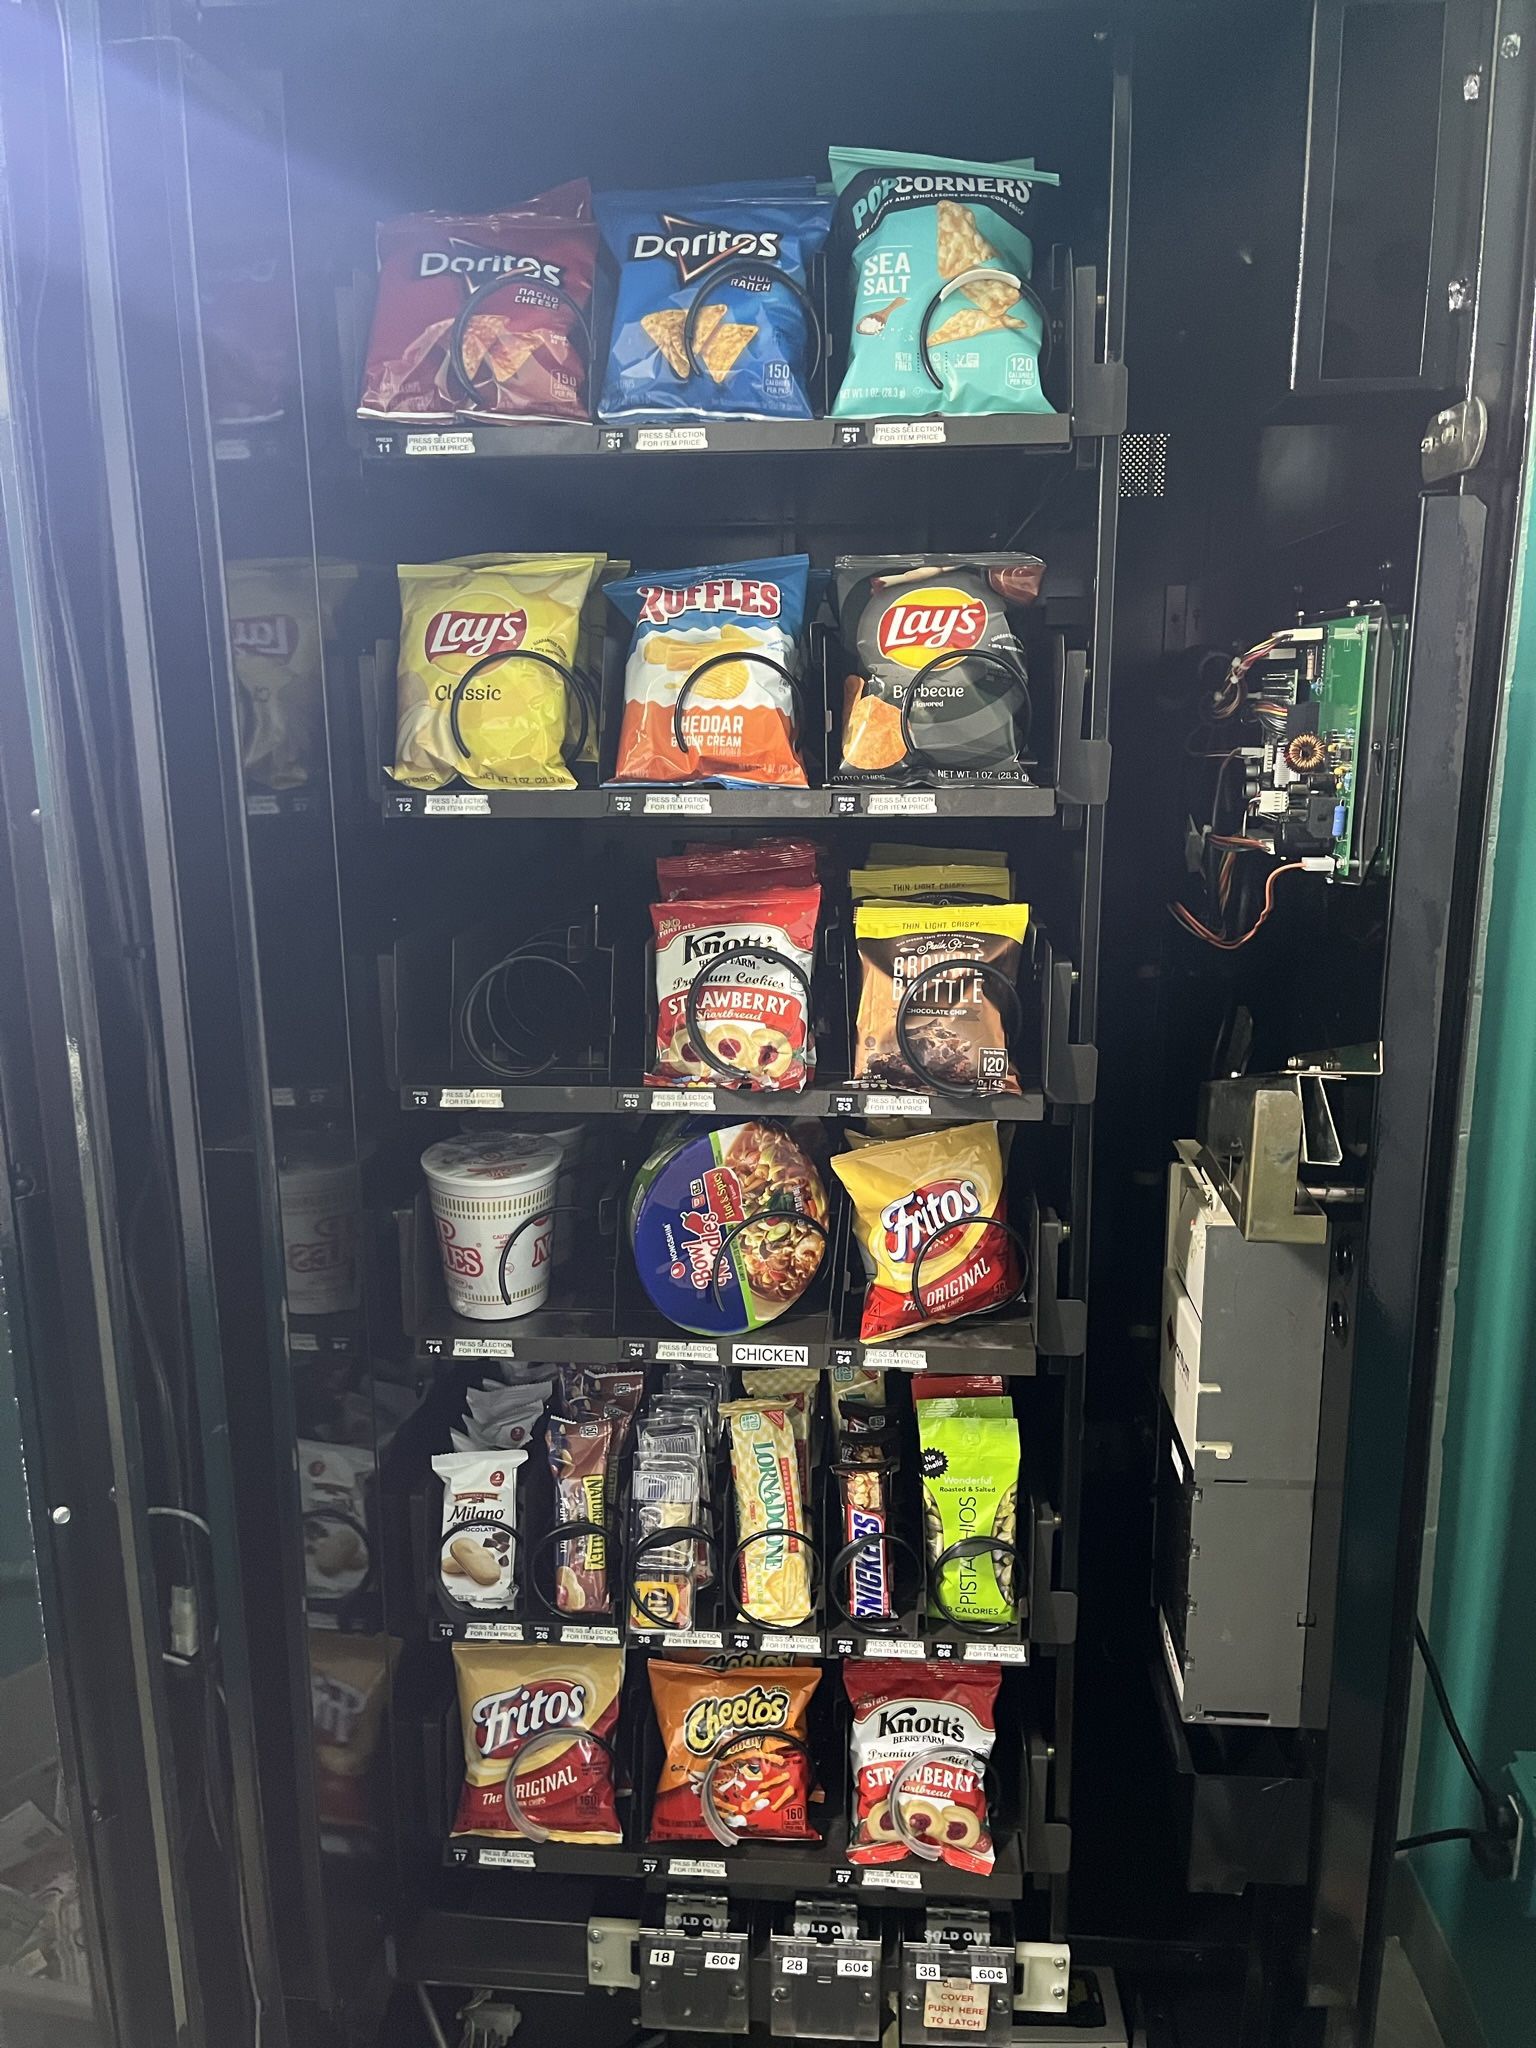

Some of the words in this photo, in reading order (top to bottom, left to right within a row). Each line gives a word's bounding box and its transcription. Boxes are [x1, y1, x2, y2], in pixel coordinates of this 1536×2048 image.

[634, 230, 779, 258] Doritos
[420, 252, 561, 287] Doritos
[864, 252, 911, 277] SEA
[730, 278, 772, 292] RANCH
[863, 275, 911, 296] SALT
[519, 287, 559, 303] NACHO
[514, 295, 560, 310] CHEESE
[1011, 357, 1032, 371] 120
[768, 363, 790, 379] 150
[555, 371, 577, 386] 150
[433, 436, 473, 444] SELECTION
[664, 431, 705, 439] SELECTION
[843, 433, 857, 443] 51
[378, 444, 391, 453] 11
[607, 439, 621, 448] 31
[639, 580, 781, 623] RUFFLES
[885, 604, 981, 649] Lay's
[430, 611, 522, 657] Lay's
[435, 684, 501, 701] Clssic
[707, 736, 742, 747] CREAM
[937, 770, 954, 778] NET
[957, 770, 971, 779] WT.
[998, 772, 1019, 780] (28.3
[398, 803, 412, 812] 12
[616, 802, 631, 811] 32
[839, 802, 854, 812] 52
[736, 972, 785, 989] Cookies
[668, 991, 792, 1015] STAWBERRY
[696, 1008, 764, 1021] Shortbread
[906, 1008, 949, 1016] CHOCOLATE
[983, 1057, 1004, 1072] 120
[414, 1096, 427, 1105] 13
[624, 1099, 638, 1107] 33
[837, 1103, 851, 1111] 53
[711, 1172, 728, 1197] Spicy
[724, 1203, 736, 1220] Hot
[881, 1180, 980, 1263] Fritos
[663, 1223, 678, 1262] NONGSHIM
[681, 1239, 712, 1290] Bowl
[926, 1257, 991, 1307] ORIGINAL
[428, 1345, 441, 1354] 14
[630, 1348, 643, 1356] 34
[735, 1348, 805, 1363] CHICKEN
[837, 1356, 851, 1364] 54
[924, 1454, 936, 1462] No
[923, 1459, 944, 1472] Shells
[752, 1441, 781, 1505] LORNA
[943, 1476, 993, 1485] Wonderful
[586, 1479, 604, 1524] NATURE
[447, 1505, 504, 1522] Milano
[763, 1503, 786, 1571] DOONE
[955, 1606, 999, 1616] CALORIES
[536, 1631, 548, 1639] 26
[638, 1636, 650, 1644] 36
[735, 1640, 748, 1648] 46
[838, 1645, 851, 1653] 56
[937, 1649, 951, 1657] 66
[471, 1684, 586, 1759] Fritos
[686, 1688, 788, 1752] Cheetos
[877, 1706, 965, 1742] Knott's
[893, 1735, 921, 1745] BERRY
[922, 1735, 945, 1746] FARM
[513, 1765, 578, 1799] RIGINAL
[482, 1792, 503, 1806] The
[786, 1807, 803, 1820] 160
[455, 1853, 466, 1861] 17
[644, 1864, 656, 1872] 37
[837, 1875, 850, 1883] 57
[665, 1915, 699, 1926] SOLD
[703, 1917, 731, 1928] OUT
[793, 1922, 828, 1933] SOLD
[830, 1926, 859, 1937] OUT
[924, 1930, 959, 1941] SOLD
[963, 1932, 991, 1942] OUT
[654, 1952, 670, 1963] 18
[707, 1955, 736, 1966] .60¢
[786, 1960, 803, 1971] 28
[841, 1963, 869, 1974] .60¢
[919, 1966, 937, 1977] 38
[975, 1969, 1004, 1980] .60¢
[941, 1993, 974, 2002] COVER
[928, 2005, 954, 2013] PUSH
[959, 2006, 985, 2015] HERE
[931, 2016, 943, 2024] TO
[949, 2018, 980, 2027] LATCH
